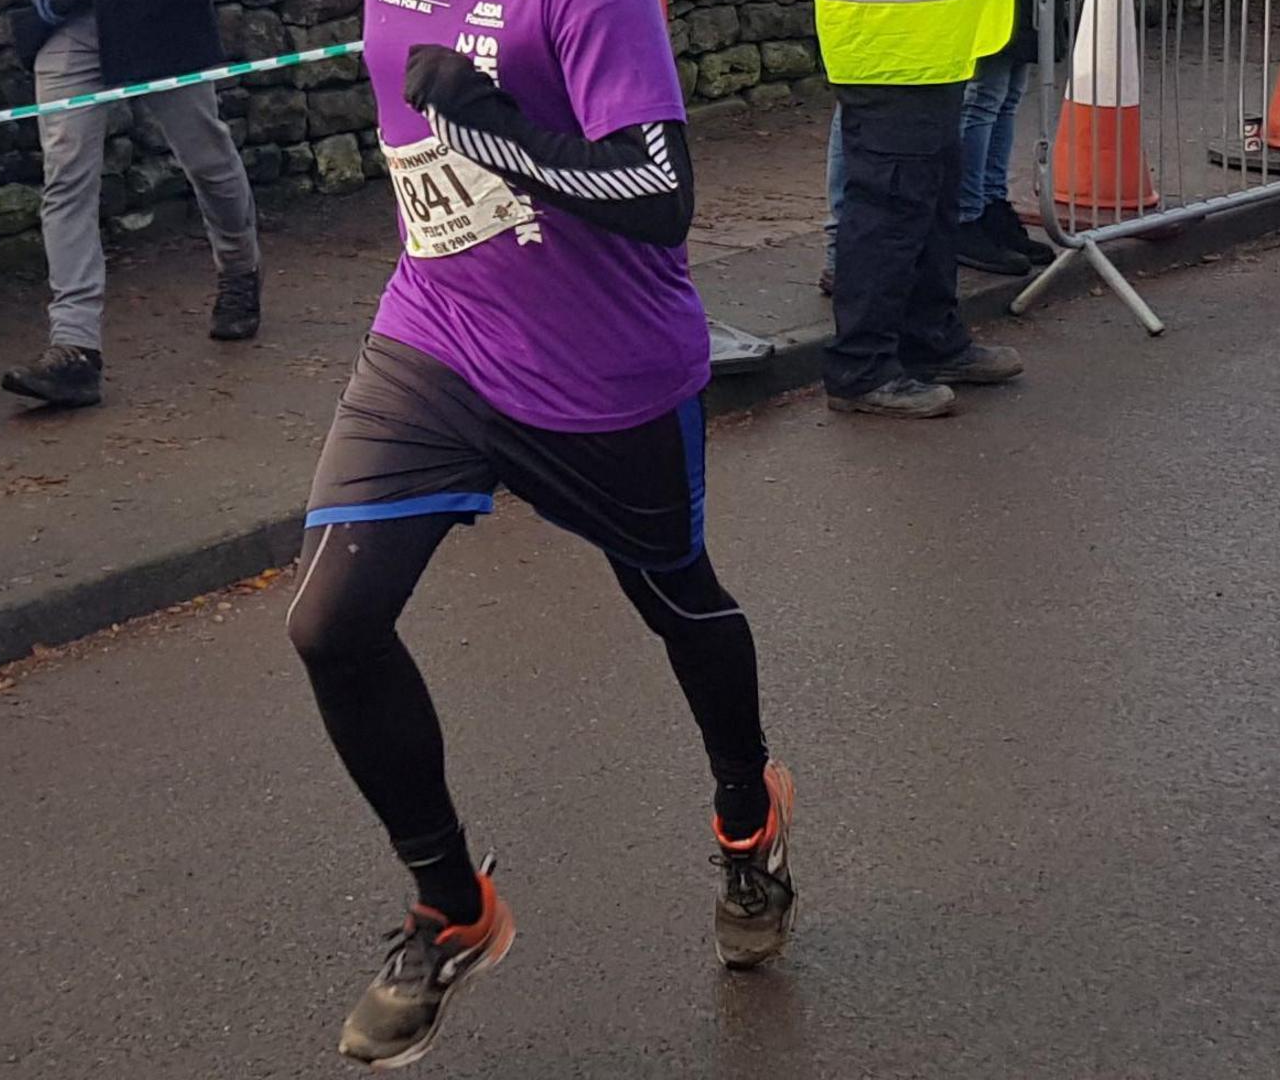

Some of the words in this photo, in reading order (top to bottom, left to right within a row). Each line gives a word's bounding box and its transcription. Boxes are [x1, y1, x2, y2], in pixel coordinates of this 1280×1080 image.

[417, 1, 433, 14] ALL
[472, 1, 503, 19] ASDA
[394, 163, 475, 223] 1841
[447, 215, 471, 232] PUD
